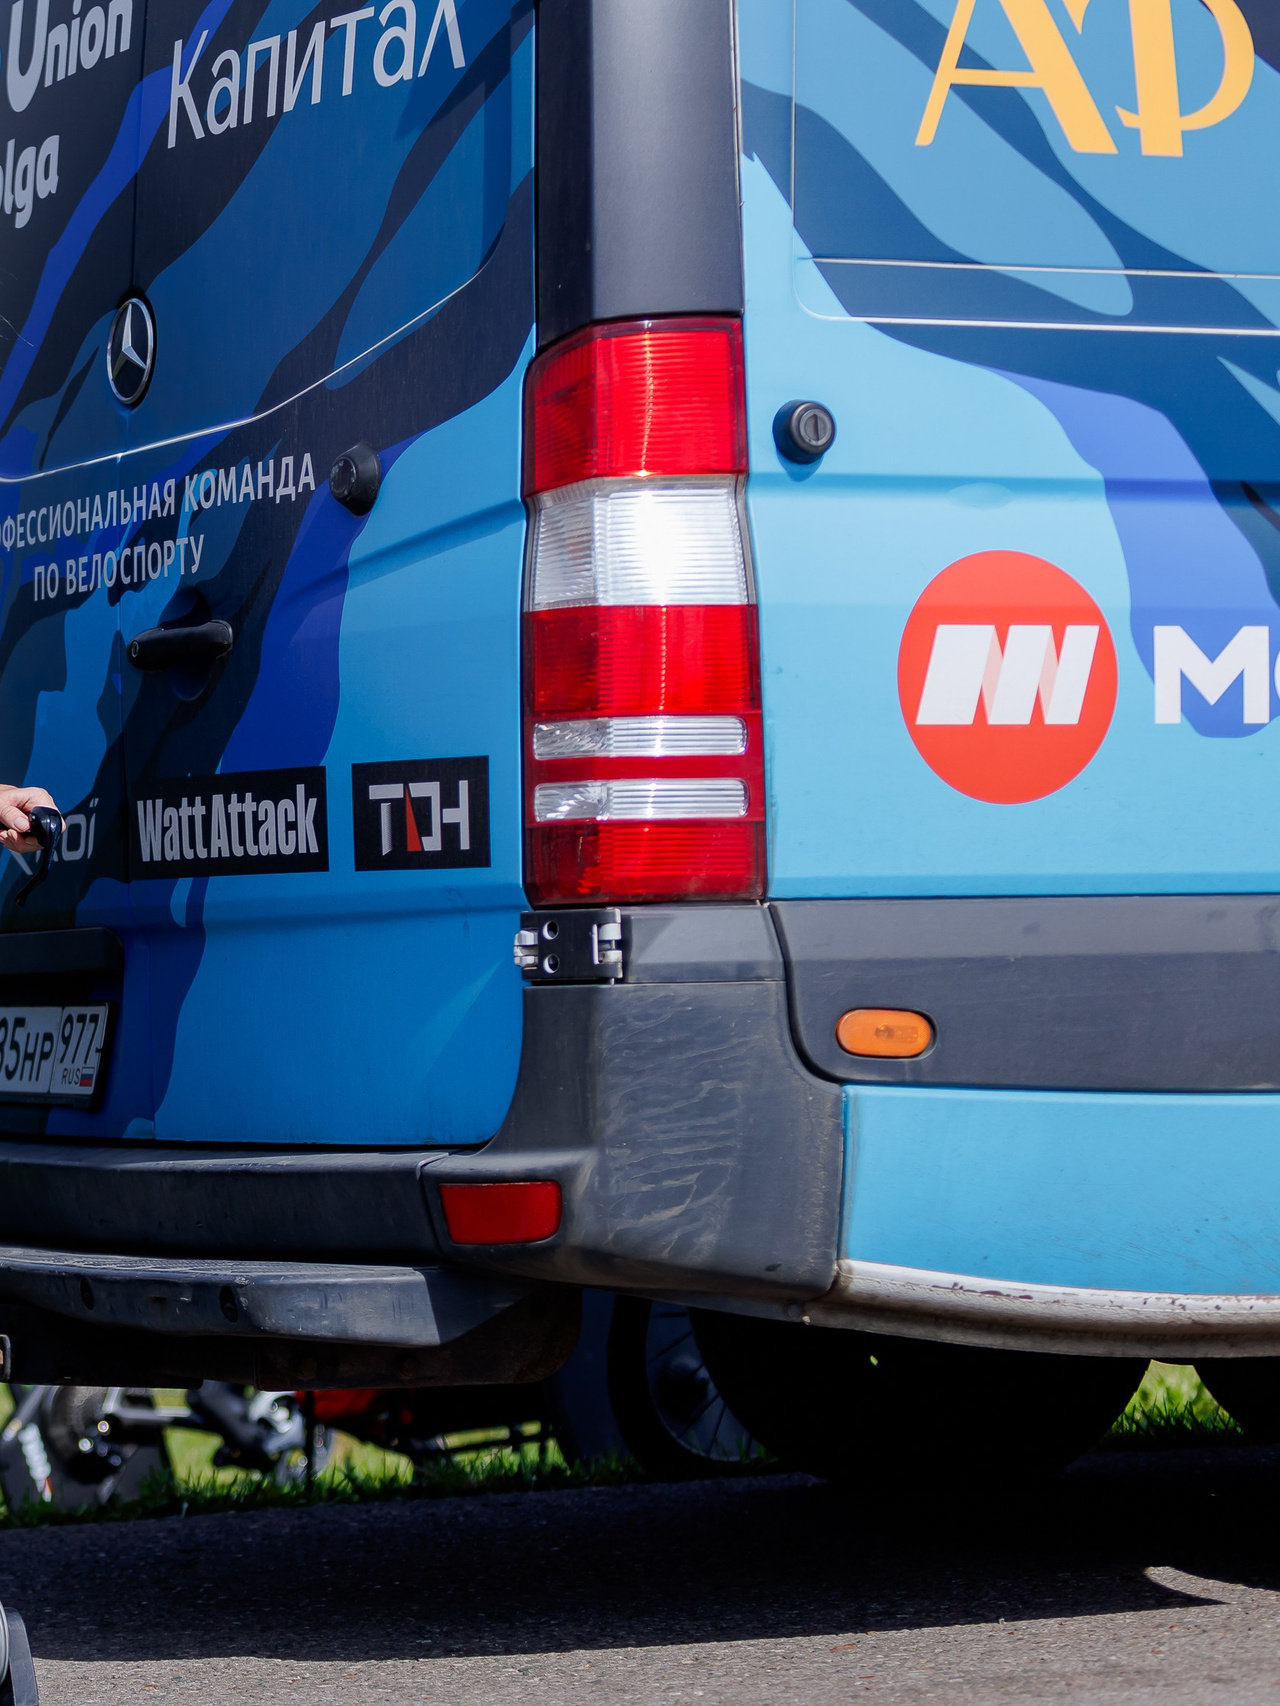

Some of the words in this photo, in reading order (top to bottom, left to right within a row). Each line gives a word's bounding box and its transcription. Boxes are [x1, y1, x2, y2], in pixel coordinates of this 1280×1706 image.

[6, 0, 131, 112] Union
[167, 0, 466, 149] Капитал
[185, 452, 316, 514] КОМАНДА
[33, 563, 59, 601] ПО
[66, 534, 205, 596] ВЕЛОСПОРТУ
[60, 1013, 100, 1065] 977
[61, 1067, 81, 1085] RUS
